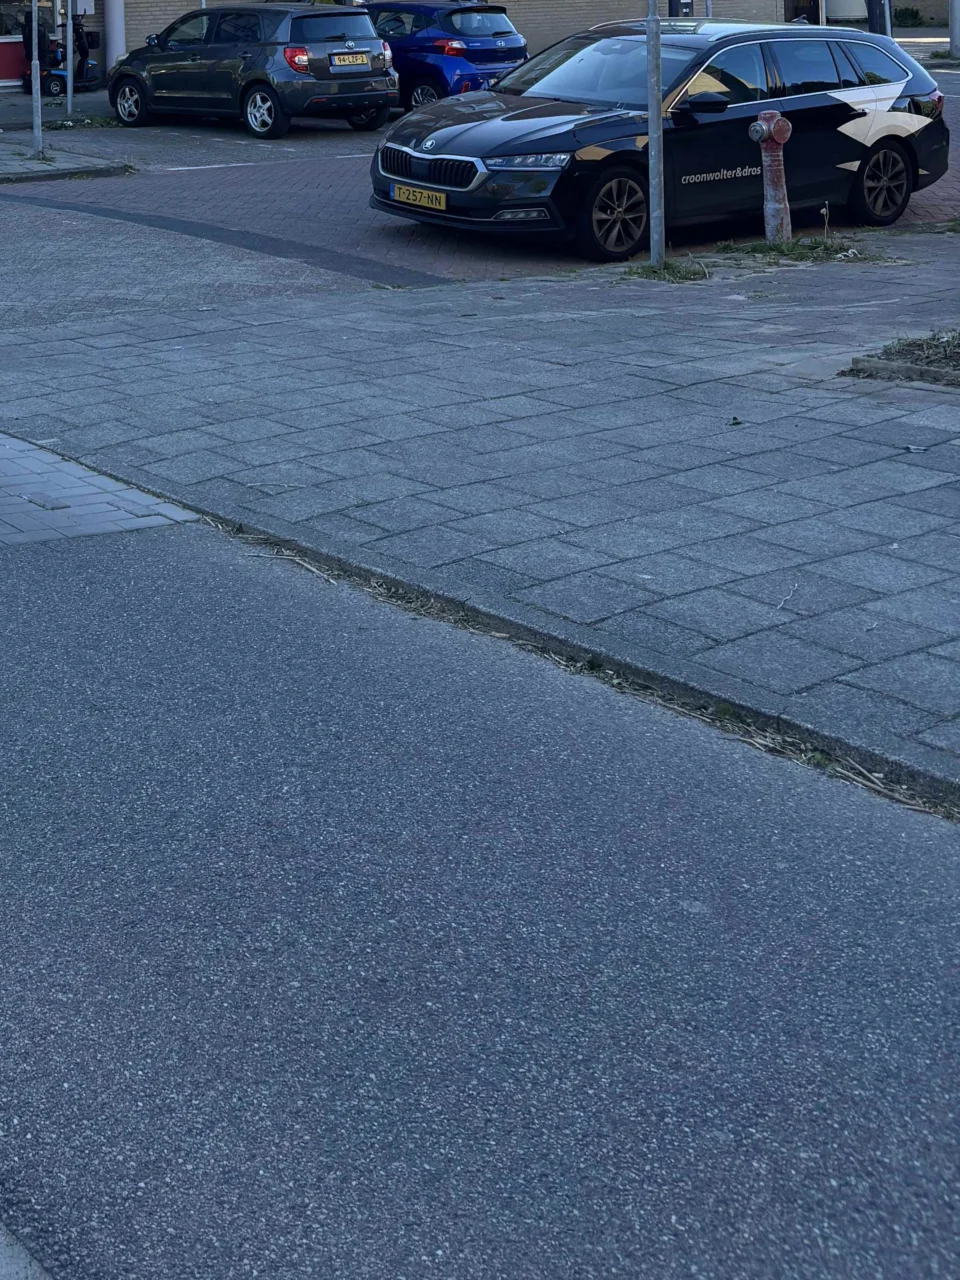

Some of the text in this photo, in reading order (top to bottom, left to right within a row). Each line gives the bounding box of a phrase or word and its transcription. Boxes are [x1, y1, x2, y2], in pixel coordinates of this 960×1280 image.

[337, 55, 366, 64] 94-LZF-2
[681, 166, 762, 184] croonwolter&dros
[396, 186, 442, 207] T-257-NN
